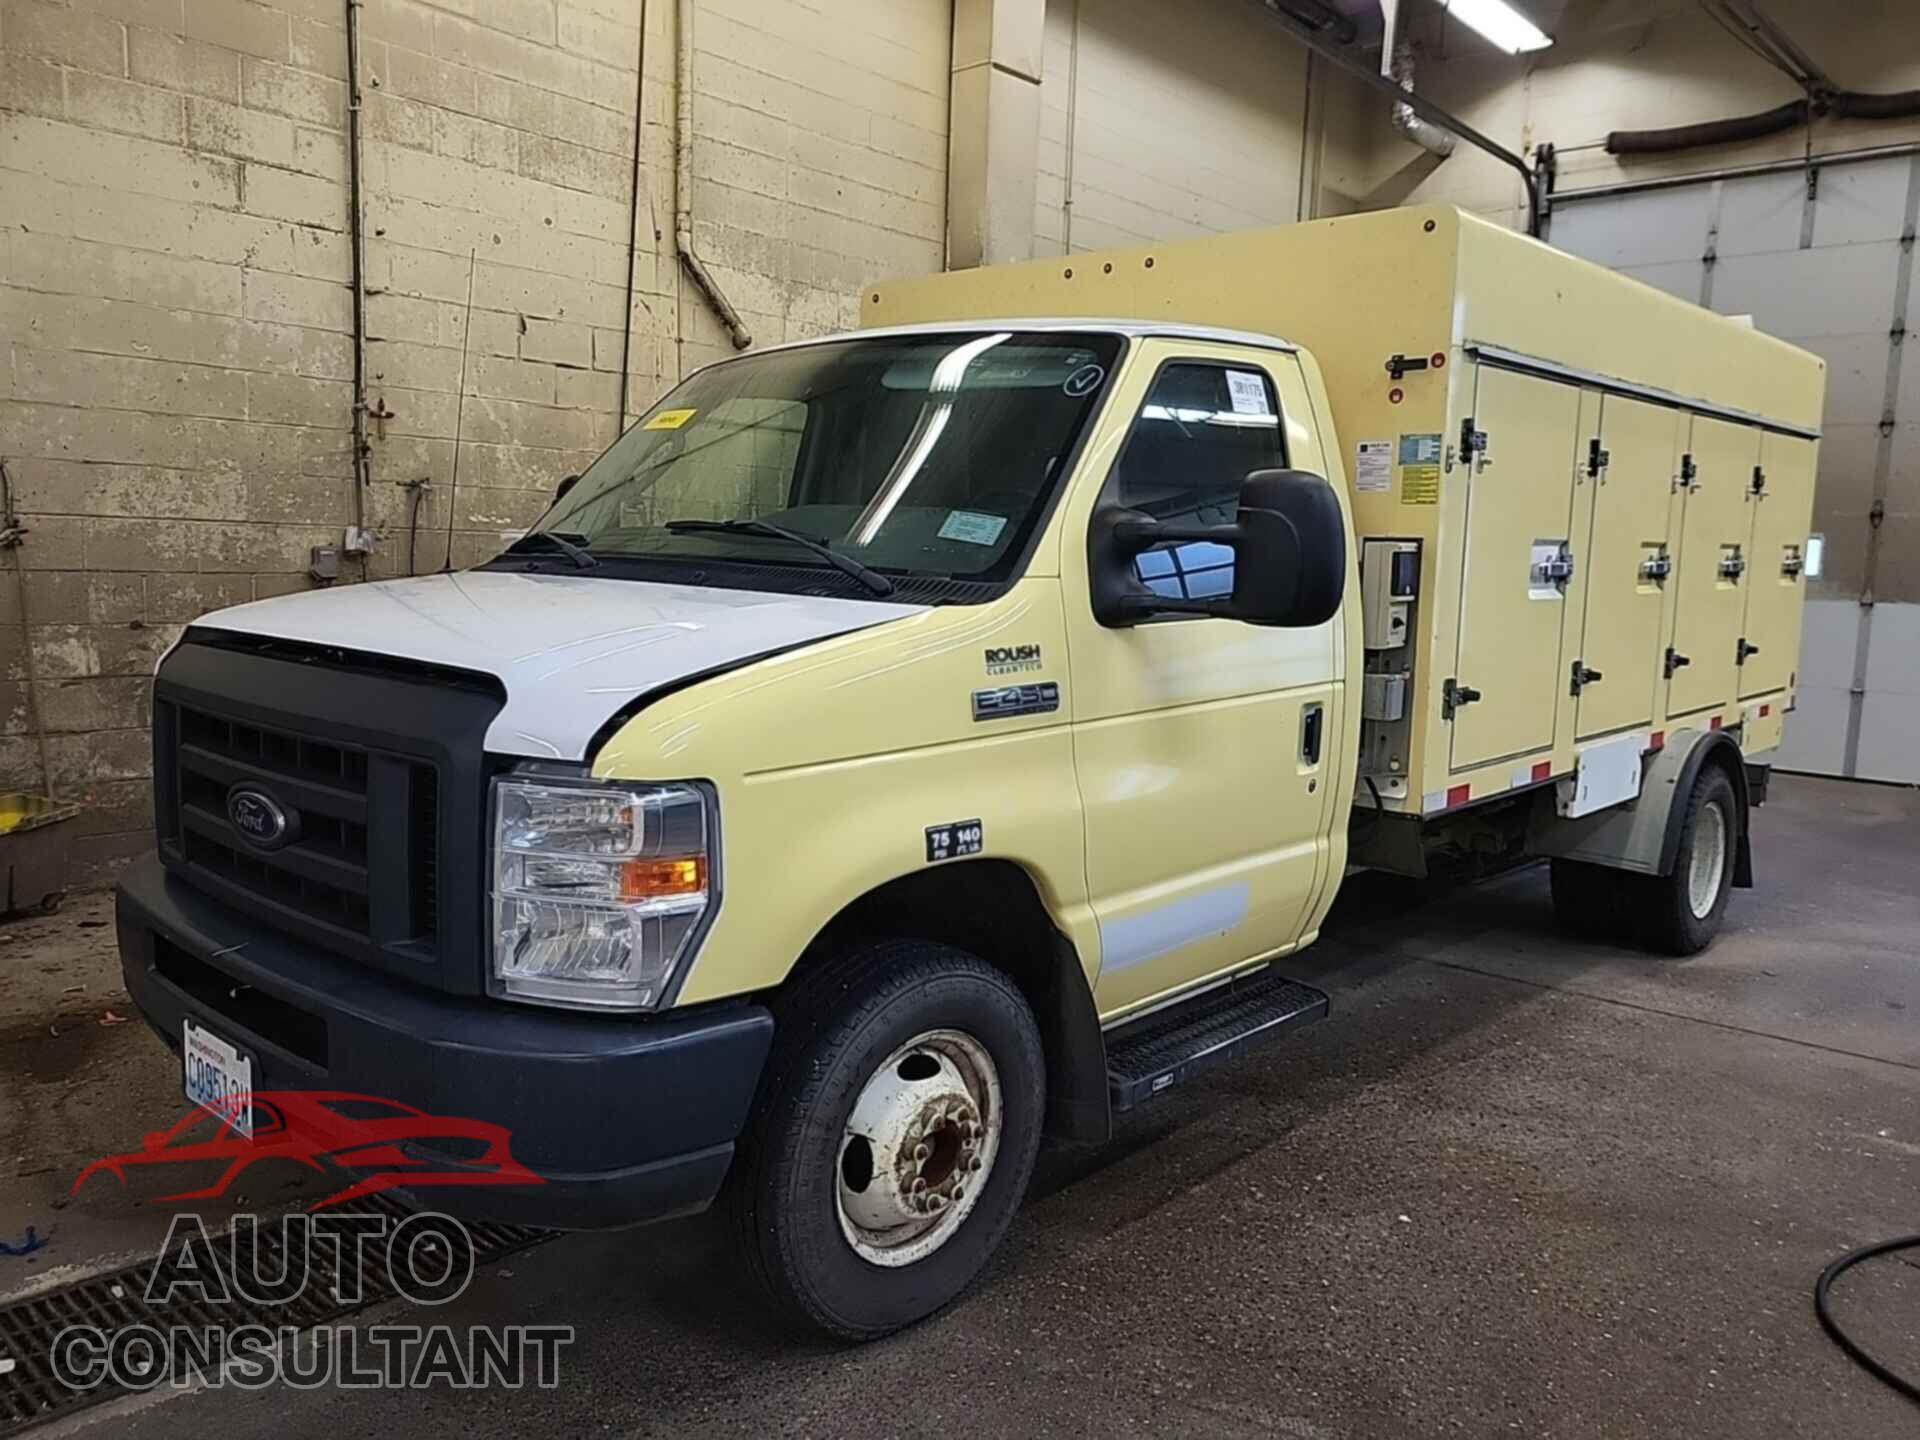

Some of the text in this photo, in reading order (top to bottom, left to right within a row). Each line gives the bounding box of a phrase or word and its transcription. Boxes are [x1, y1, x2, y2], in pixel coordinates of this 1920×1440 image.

[985, 644, 1040, 663] ROUSH
[236, 799, 265, 832] Ford
[931, 826, 980, 848] 75 140
